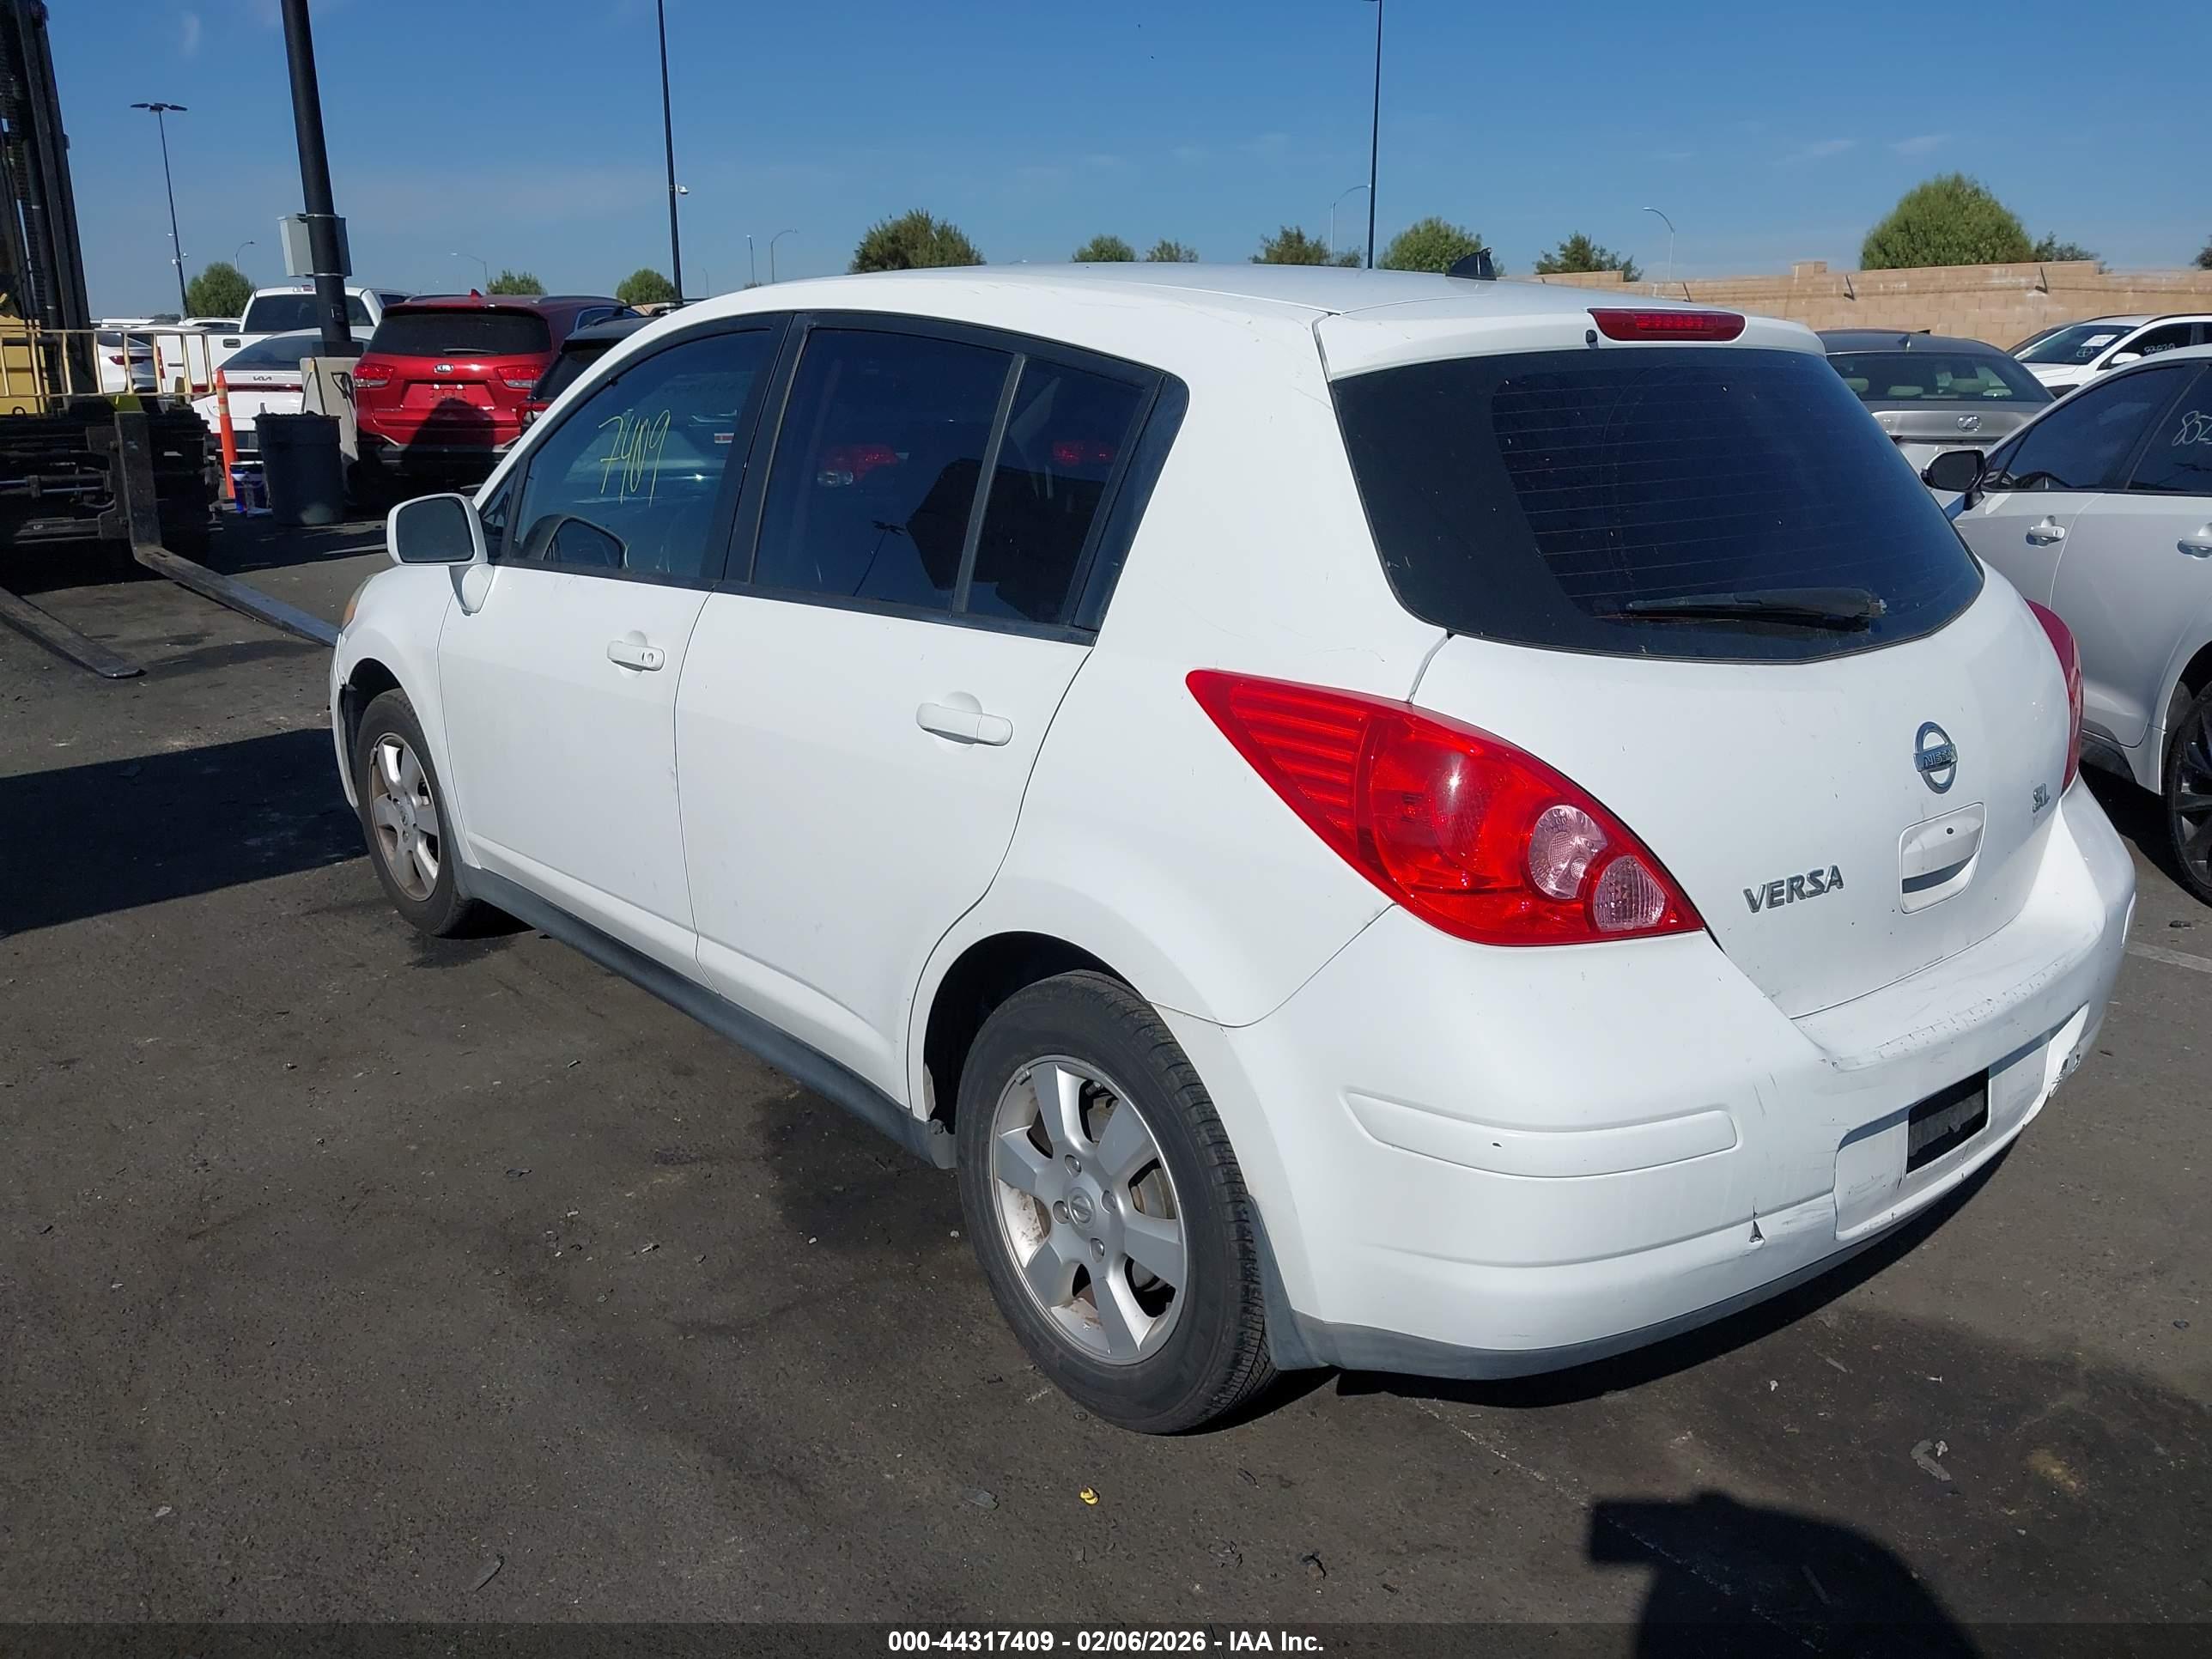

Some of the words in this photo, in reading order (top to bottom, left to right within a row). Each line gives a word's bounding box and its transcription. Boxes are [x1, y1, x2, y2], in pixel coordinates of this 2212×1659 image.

[599, 410, 672, 508] 7409
[2032, 782, 2051, 813] SL
[1742, 864, 1844, 914] VERSA
